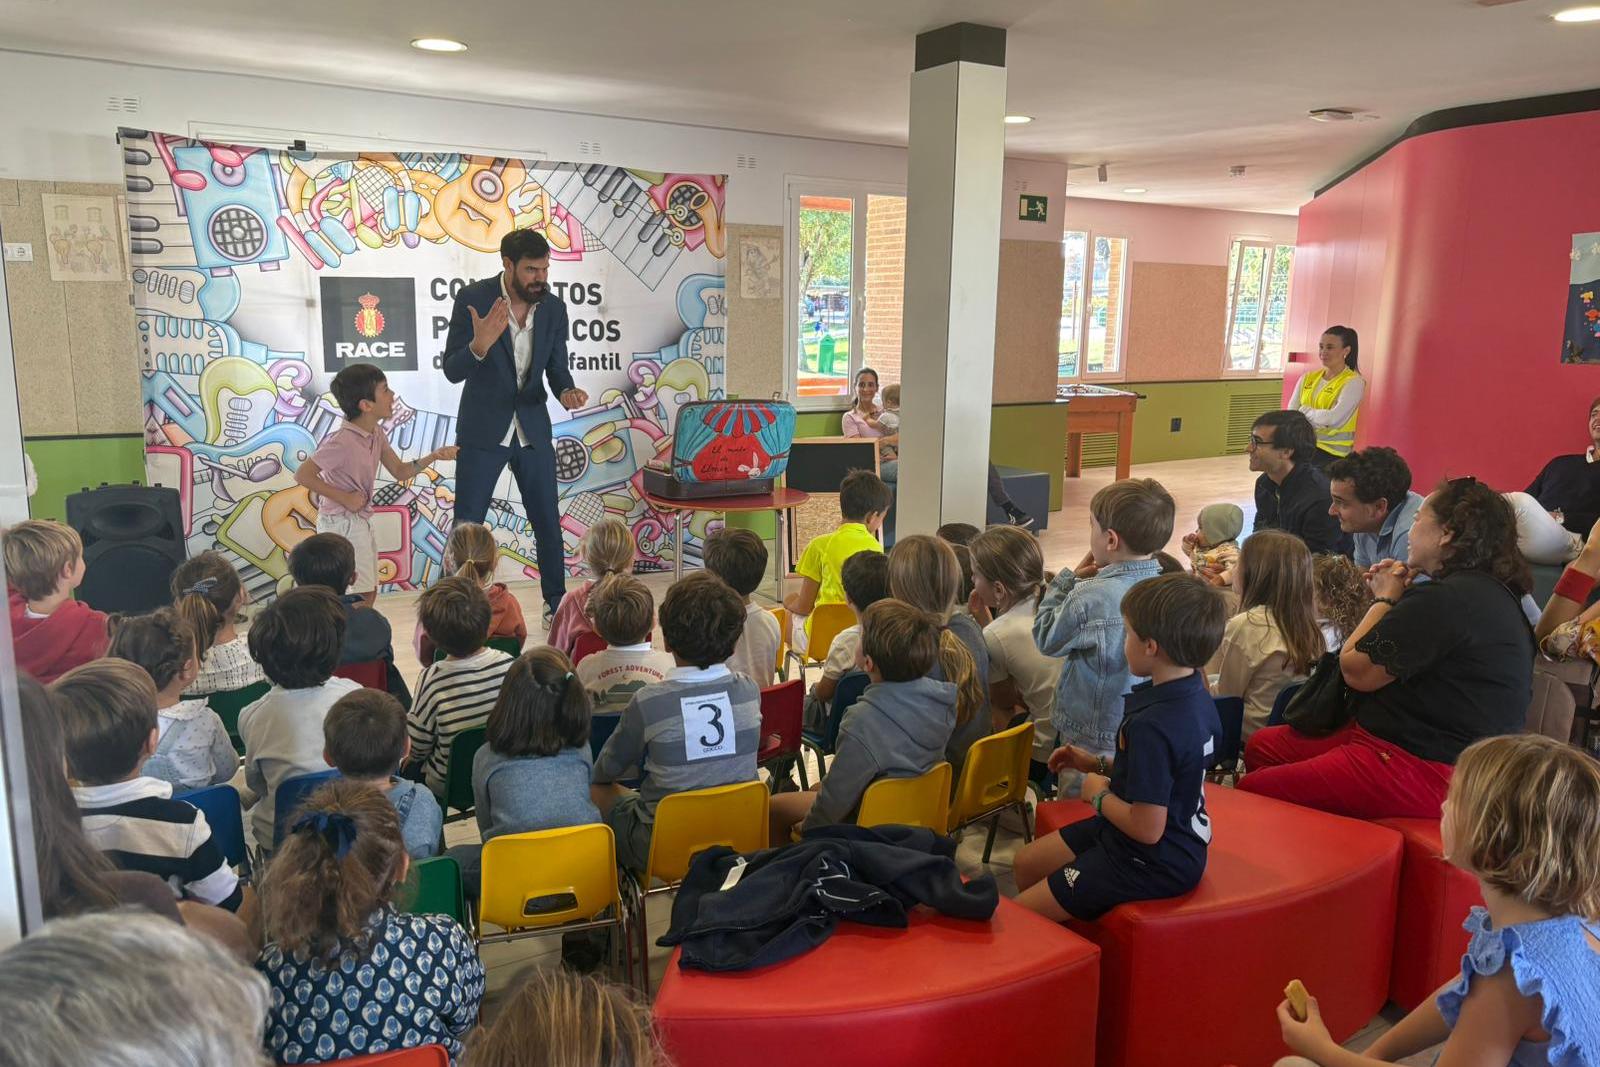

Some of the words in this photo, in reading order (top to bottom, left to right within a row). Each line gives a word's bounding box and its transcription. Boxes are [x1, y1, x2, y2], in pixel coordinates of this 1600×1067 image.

[335, 342, 406, 358] RACE
[598, 666, 623, 680] FOREST
[625, 664, 665, 680] ADVENTURE
[698, 703, 724, 747] 3
